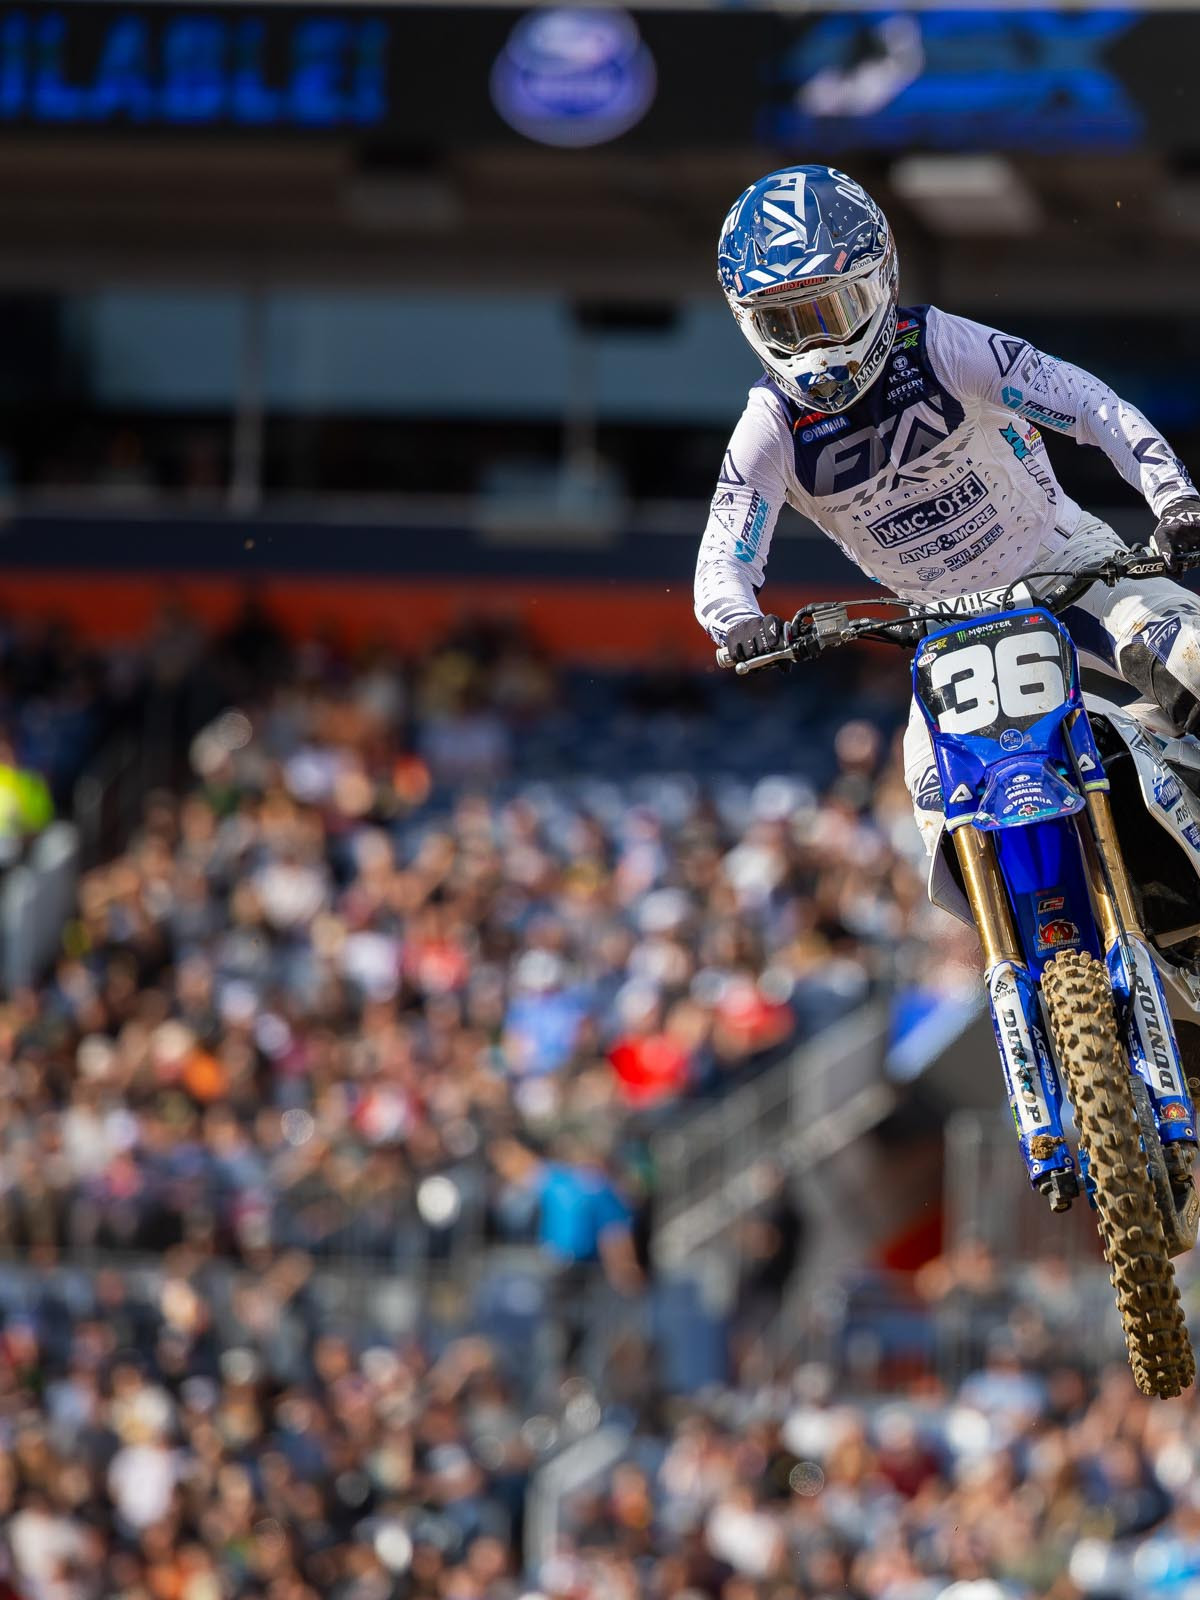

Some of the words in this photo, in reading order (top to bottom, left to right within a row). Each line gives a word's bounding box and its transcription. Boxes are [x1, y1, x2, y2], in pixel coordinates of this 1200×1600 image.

[886, 377, 924, 401] JEFFERY
[1024, 400, 1076, 424] FACTORY
[811, 417, 847, 438] YAMAHA
[741, 487, 761, 543] FACTORY
[852, 499, 893, 522] MOTO
[877, 476, 980, 543] Muc-Off
[931, 631, 1065, 735] 36
[1012, 796, 1052, 806] YAMAHA
[1135, 974, 1176, 1092] DUNLOP
